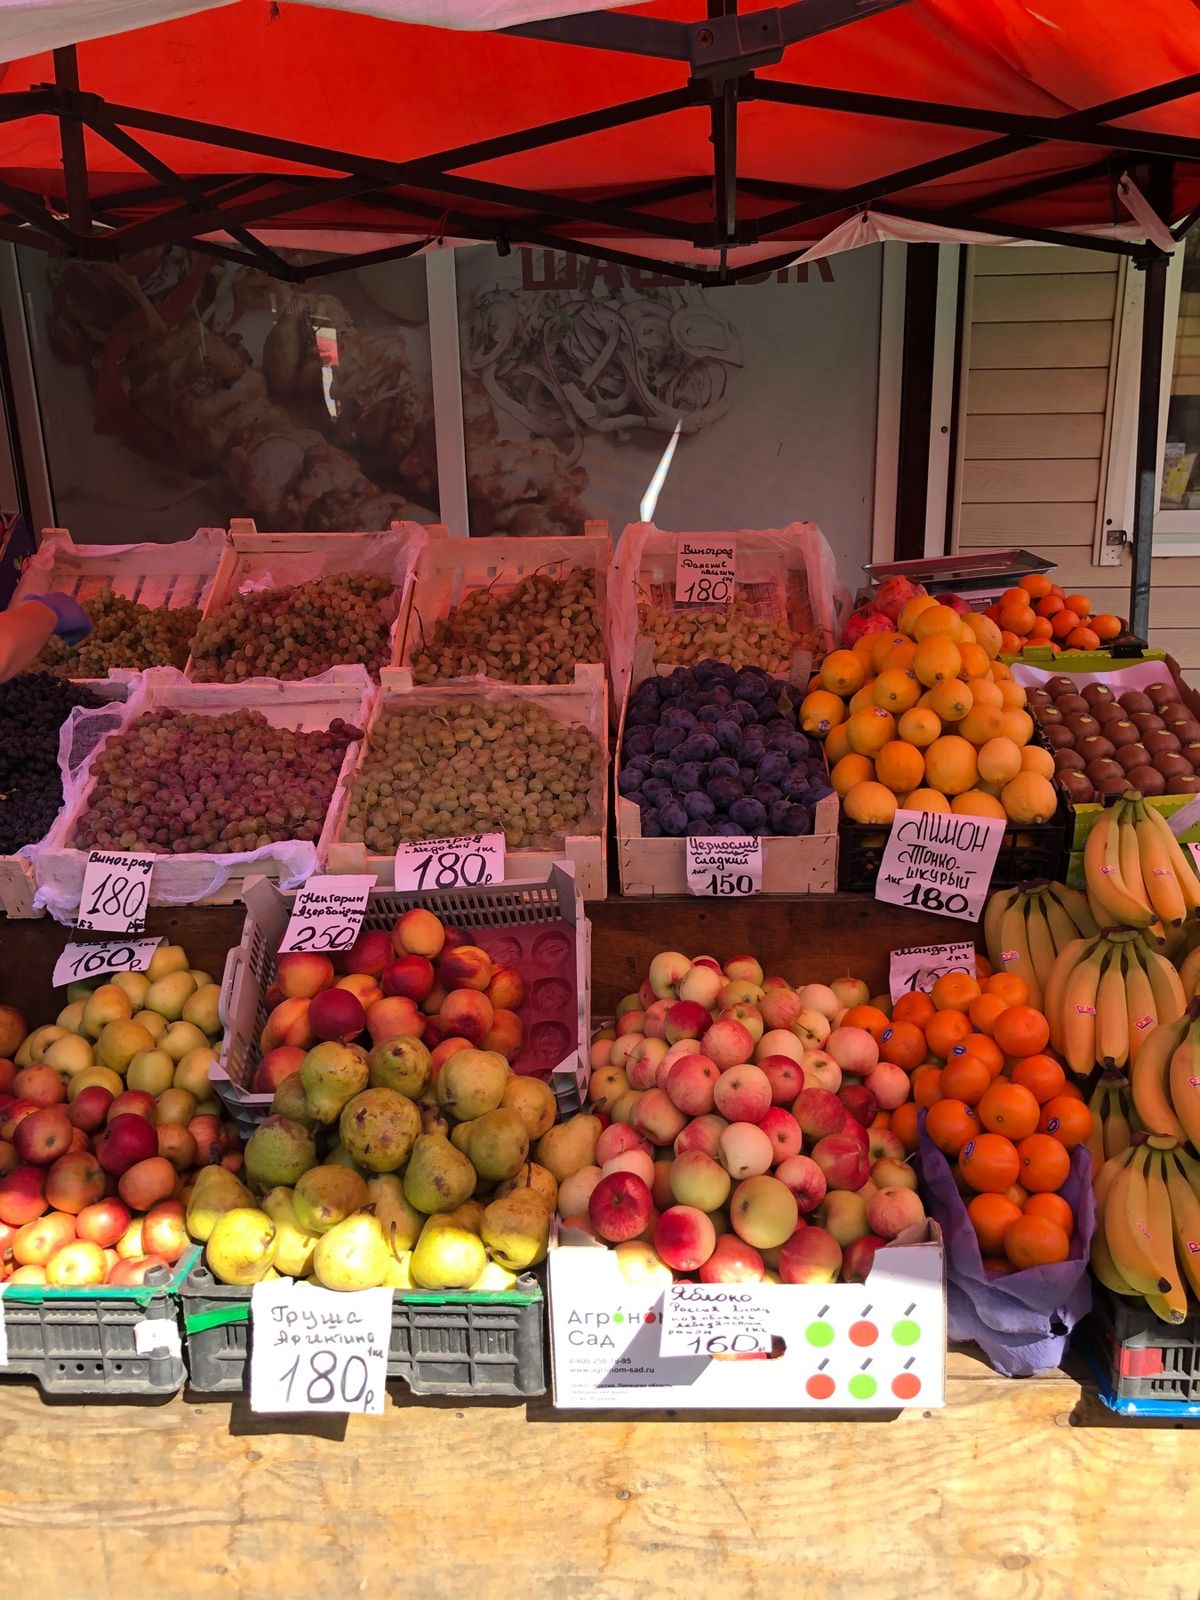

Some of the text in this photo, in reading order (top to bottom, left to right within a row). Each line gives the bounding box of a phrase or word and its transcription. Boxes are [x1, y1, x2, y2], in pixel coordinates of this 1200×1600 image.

[680, 544, 733, 559] Виноград
[88, 852, 154, 875] Виноград
[694, 853, 750, 871] сладкий
[87, 873, 146, 918] 180
[298, 892, 365, 907] Нектарин
[894, 943, 974, 956] Мандарин
[903, 966, 971, 995] 15
[671, 1286, 753, 1303] Яблоко
[669, 1302, 720, 1313] Россия
[271, 1305, 363, 1330] Груша
[567, 1306, 663, 1329] Агроно
[568, 1330, 616, 1349] Сад
